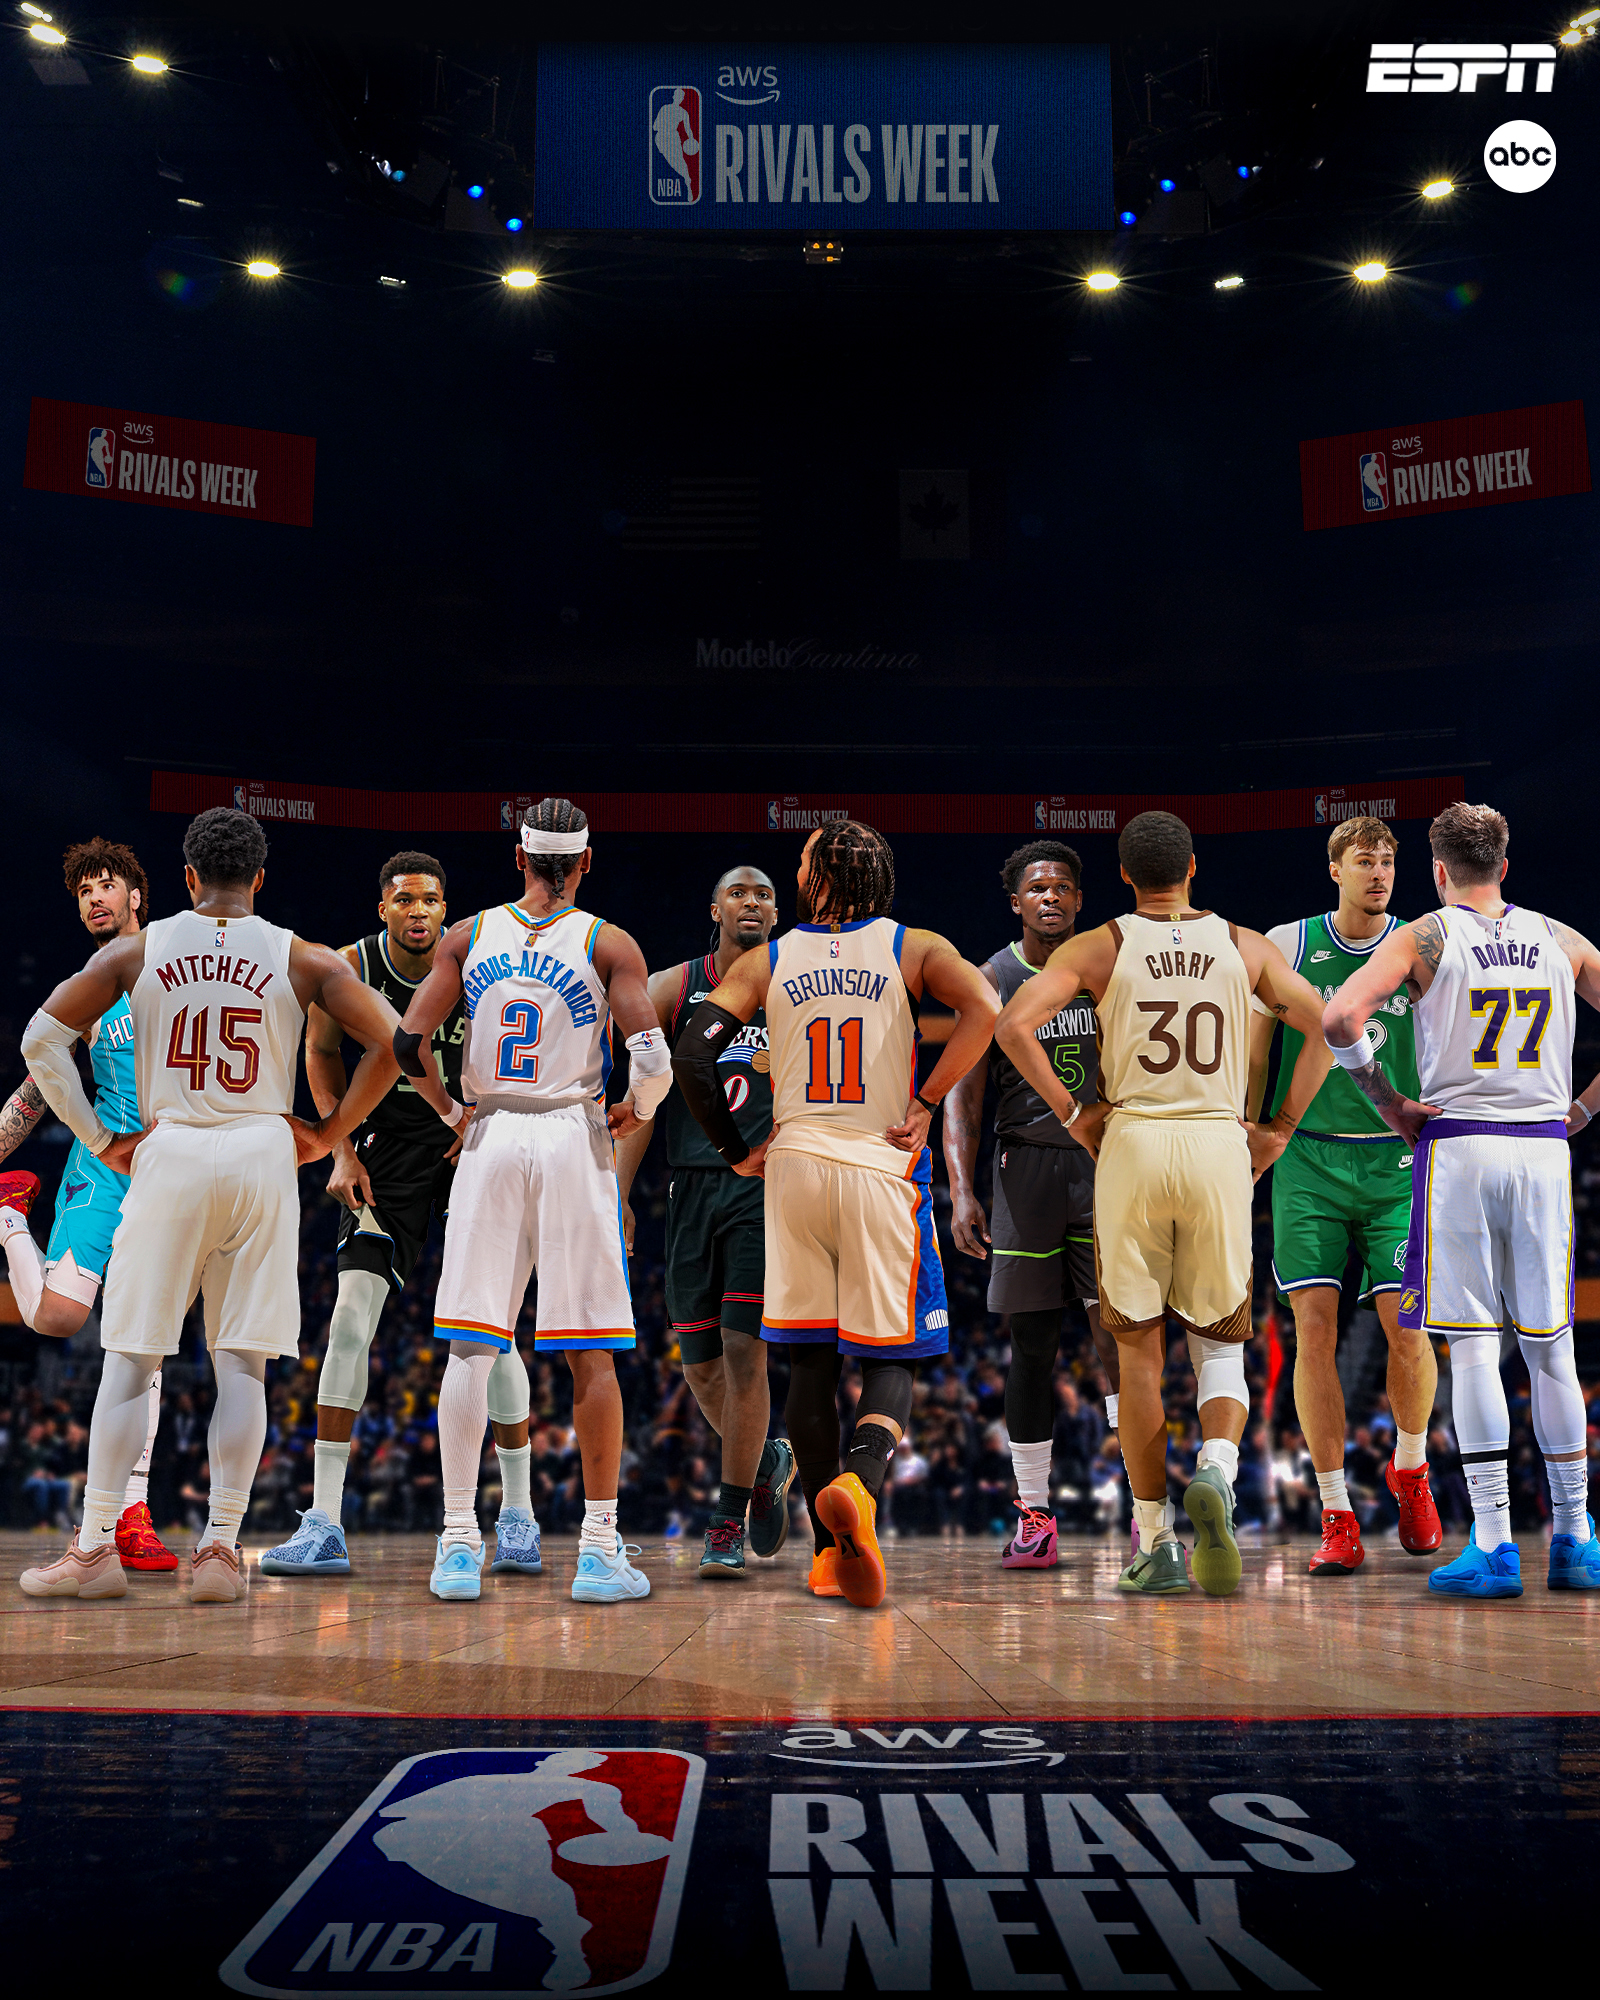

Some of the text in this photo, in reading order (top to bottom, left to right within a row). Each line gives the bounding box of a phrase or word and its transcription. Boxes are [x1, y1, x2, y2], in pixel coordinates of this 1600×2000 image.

[717, 65, 778, 87] aws
[715, 124, 1000, 203] RIVALS WEEK
[657, 178, 682, 198] NBA
[123, 421, 154, 437] aws
[1391, 435, 1422, 451] aws
[118, 450, 258, 508] RIVALS WEEK
[1392, 447, 1533, 506] RIVALS WEEK
[696, 636, 922, 672] Modelo Cantina
[248, 795, 315, 821] RIVALS WEEK
[1329, 798, 1396, 822] RIVALS WEEK
[1330, 788, 1346, 796] aws
[783, 810, 820, 830] RIVALS
[1049, 810, 1116, 830] RIVALS WEEK
[1145, 951, 1215, 981] CURRY
[1471, 939, 1540, 970] DONČIĆ
[155, 954, 274, 1000] MITCHELL
[782, 968, 889, 1008] BRUNSON
[495, 998, 543, 1084] 2
[1136, 1001, 1224, 1075] 30
[1469, 987, 1553, 1069] 77
[165, 1003, 263, 1095] 45
[806, 1016, 866, 1105] 11
[1054, 1043, 1085, 1092] 5
[781, 1727, 1046, 1749] aws
[768, 1793, 1357, 1873] RIVALS
[290, 1922, 499, 1972] NBA
[766, 1878, 1324, 1991] WEEK
